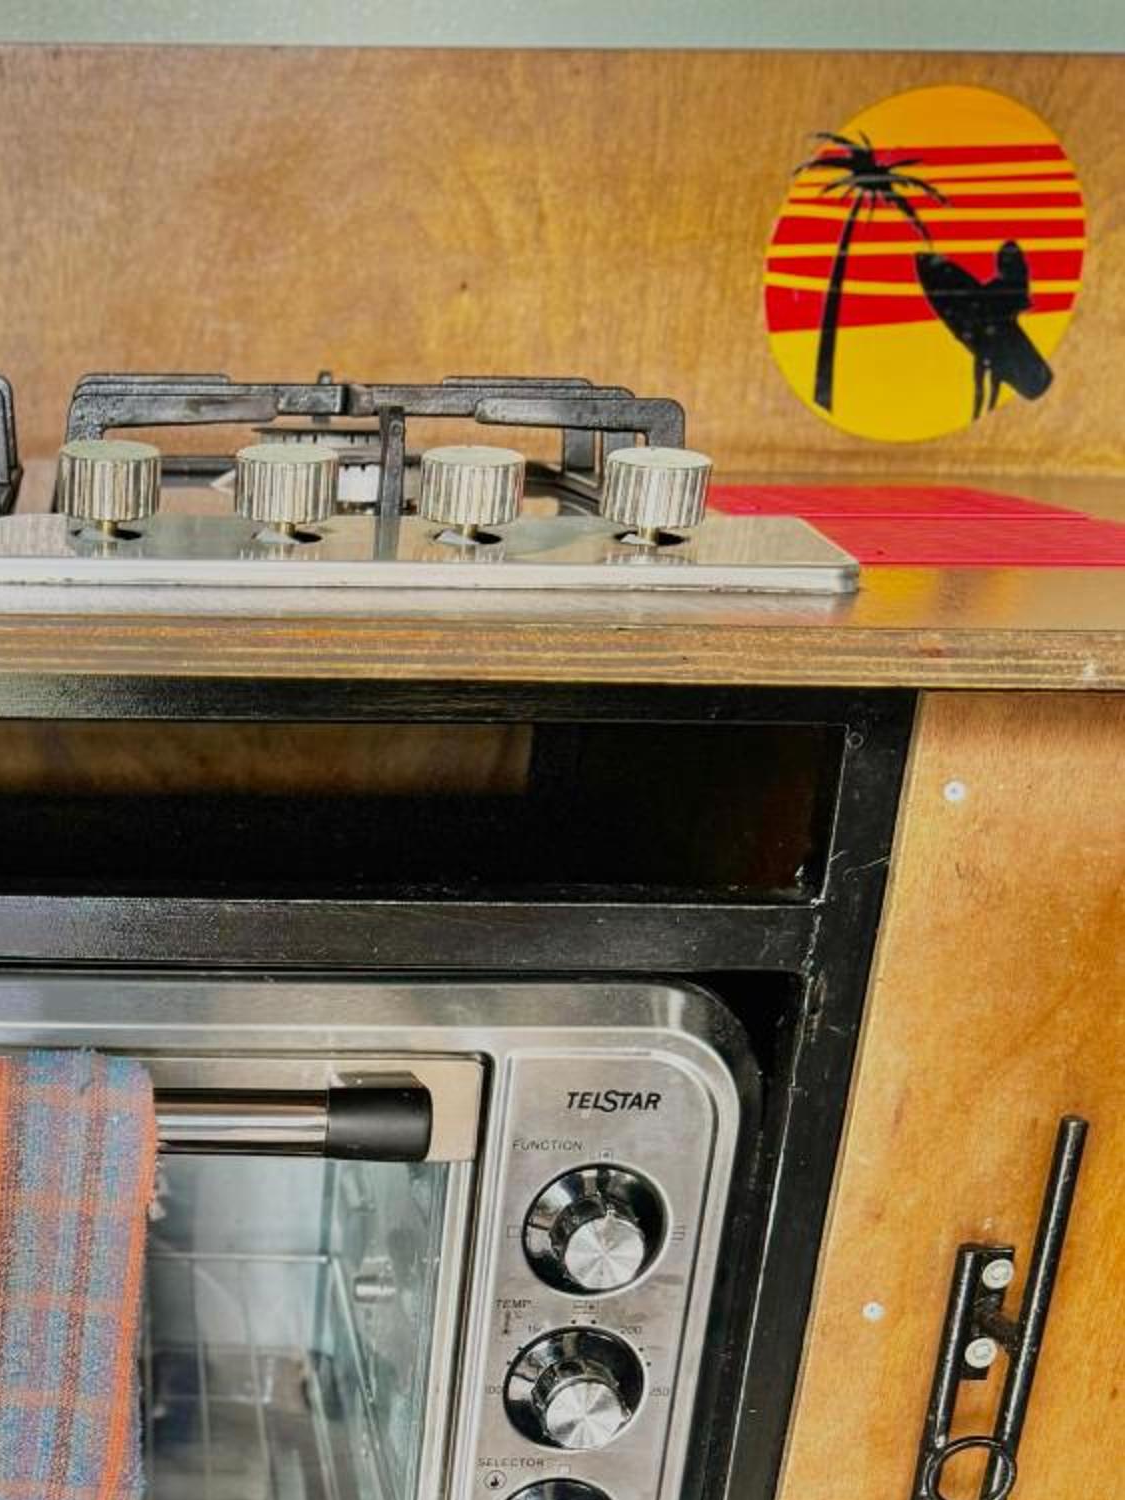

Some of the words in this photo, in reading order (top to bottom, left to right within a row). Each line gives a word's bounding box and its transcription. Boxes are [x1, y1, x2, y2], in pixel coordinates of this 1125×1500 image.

[567, 1090, 661, 1112] TELSTAR
[512, 1139, 584, 1151] FUNCTION
[478, 1457, 544, 1468] SELECTOR
